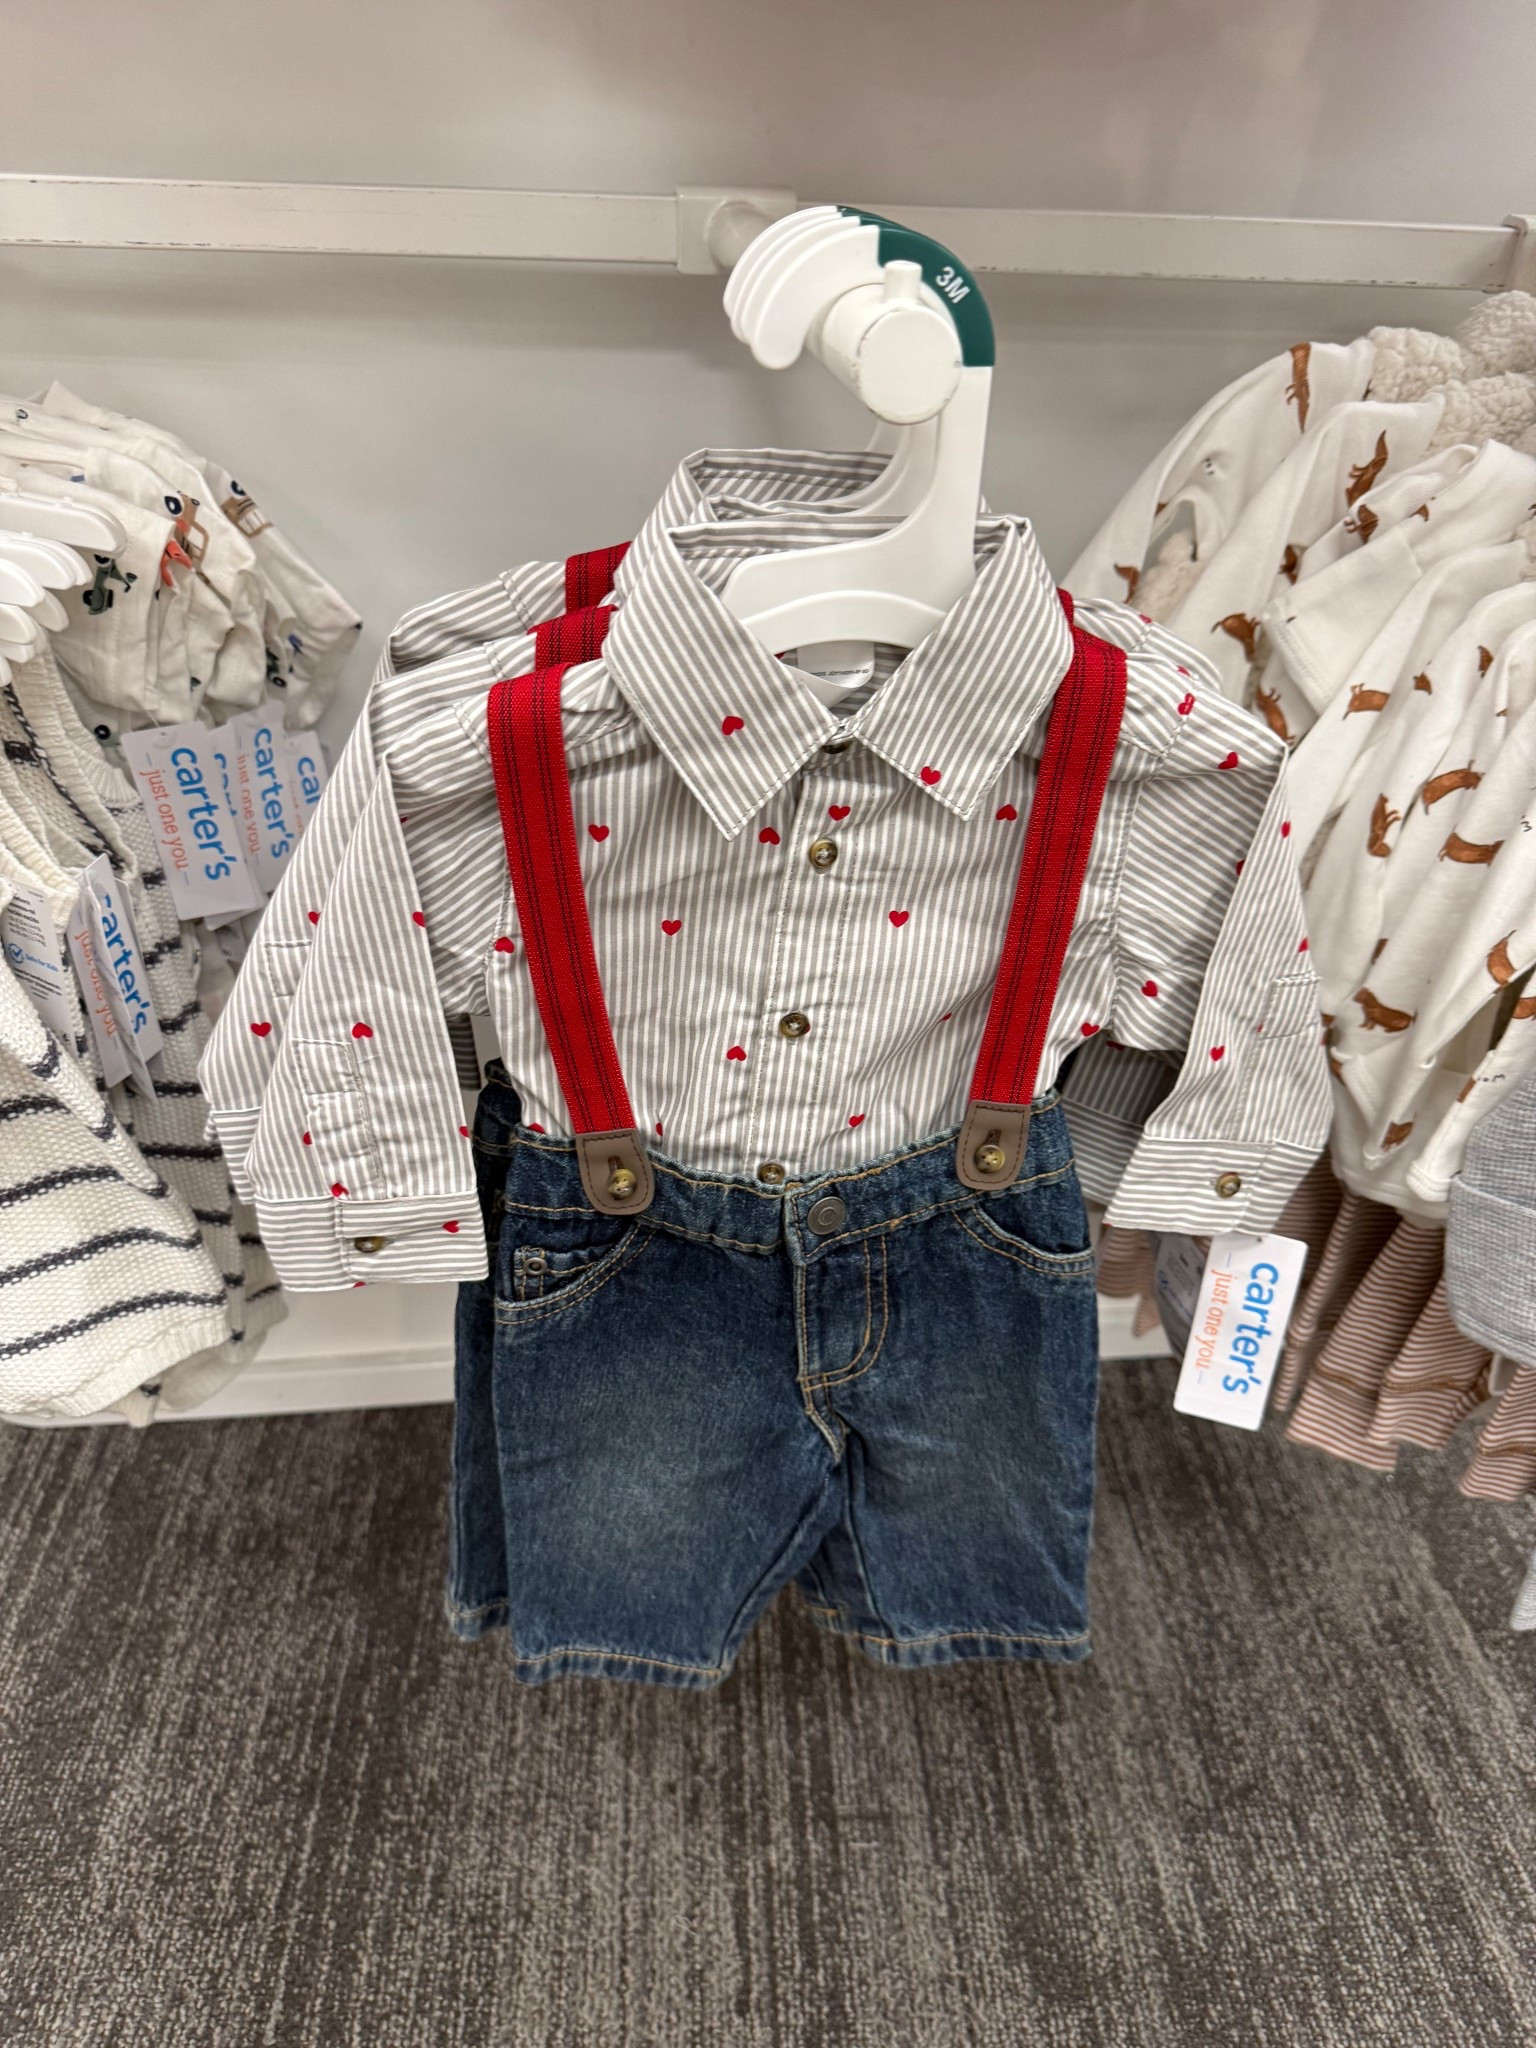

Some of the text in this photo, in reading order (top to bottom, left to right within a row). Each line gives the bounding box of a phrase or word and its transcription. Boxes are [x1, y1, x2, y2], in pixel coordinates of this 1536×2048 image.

[935, 266, 970, 304] 3M
[139, 768, 190, 871] just one you
[171, 748, 237, 880] carter's
[254, 728, 295, 859] carter's
[1195, 1269, 1238, 1370] just one you
[1222, 1262, 1279, 1394] carter's
